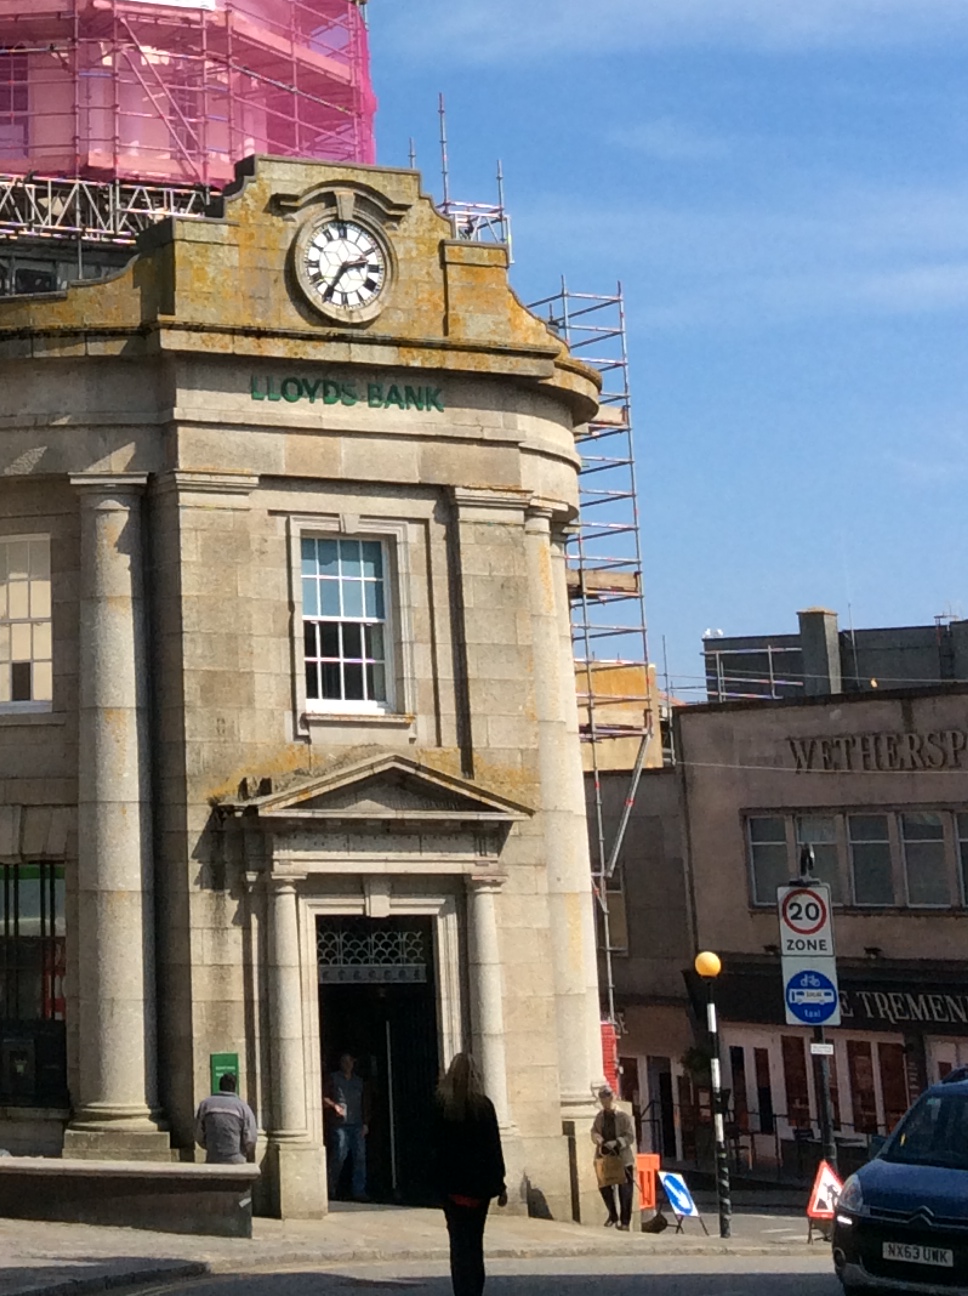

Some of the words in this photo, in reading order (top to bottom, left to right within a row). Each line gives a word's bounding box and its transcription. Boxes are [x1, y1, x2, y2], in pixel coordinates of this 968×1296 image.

[250, 375, 357, 406] LLOYDS
[367, 382, 444, 412] BANK
[785, 730, 968, 771] WETHERSP
[788, 902, 820, 921] 20
[786, 938, 828, 951] ZONE
[856, 990, 968, 1024] TREMEN
